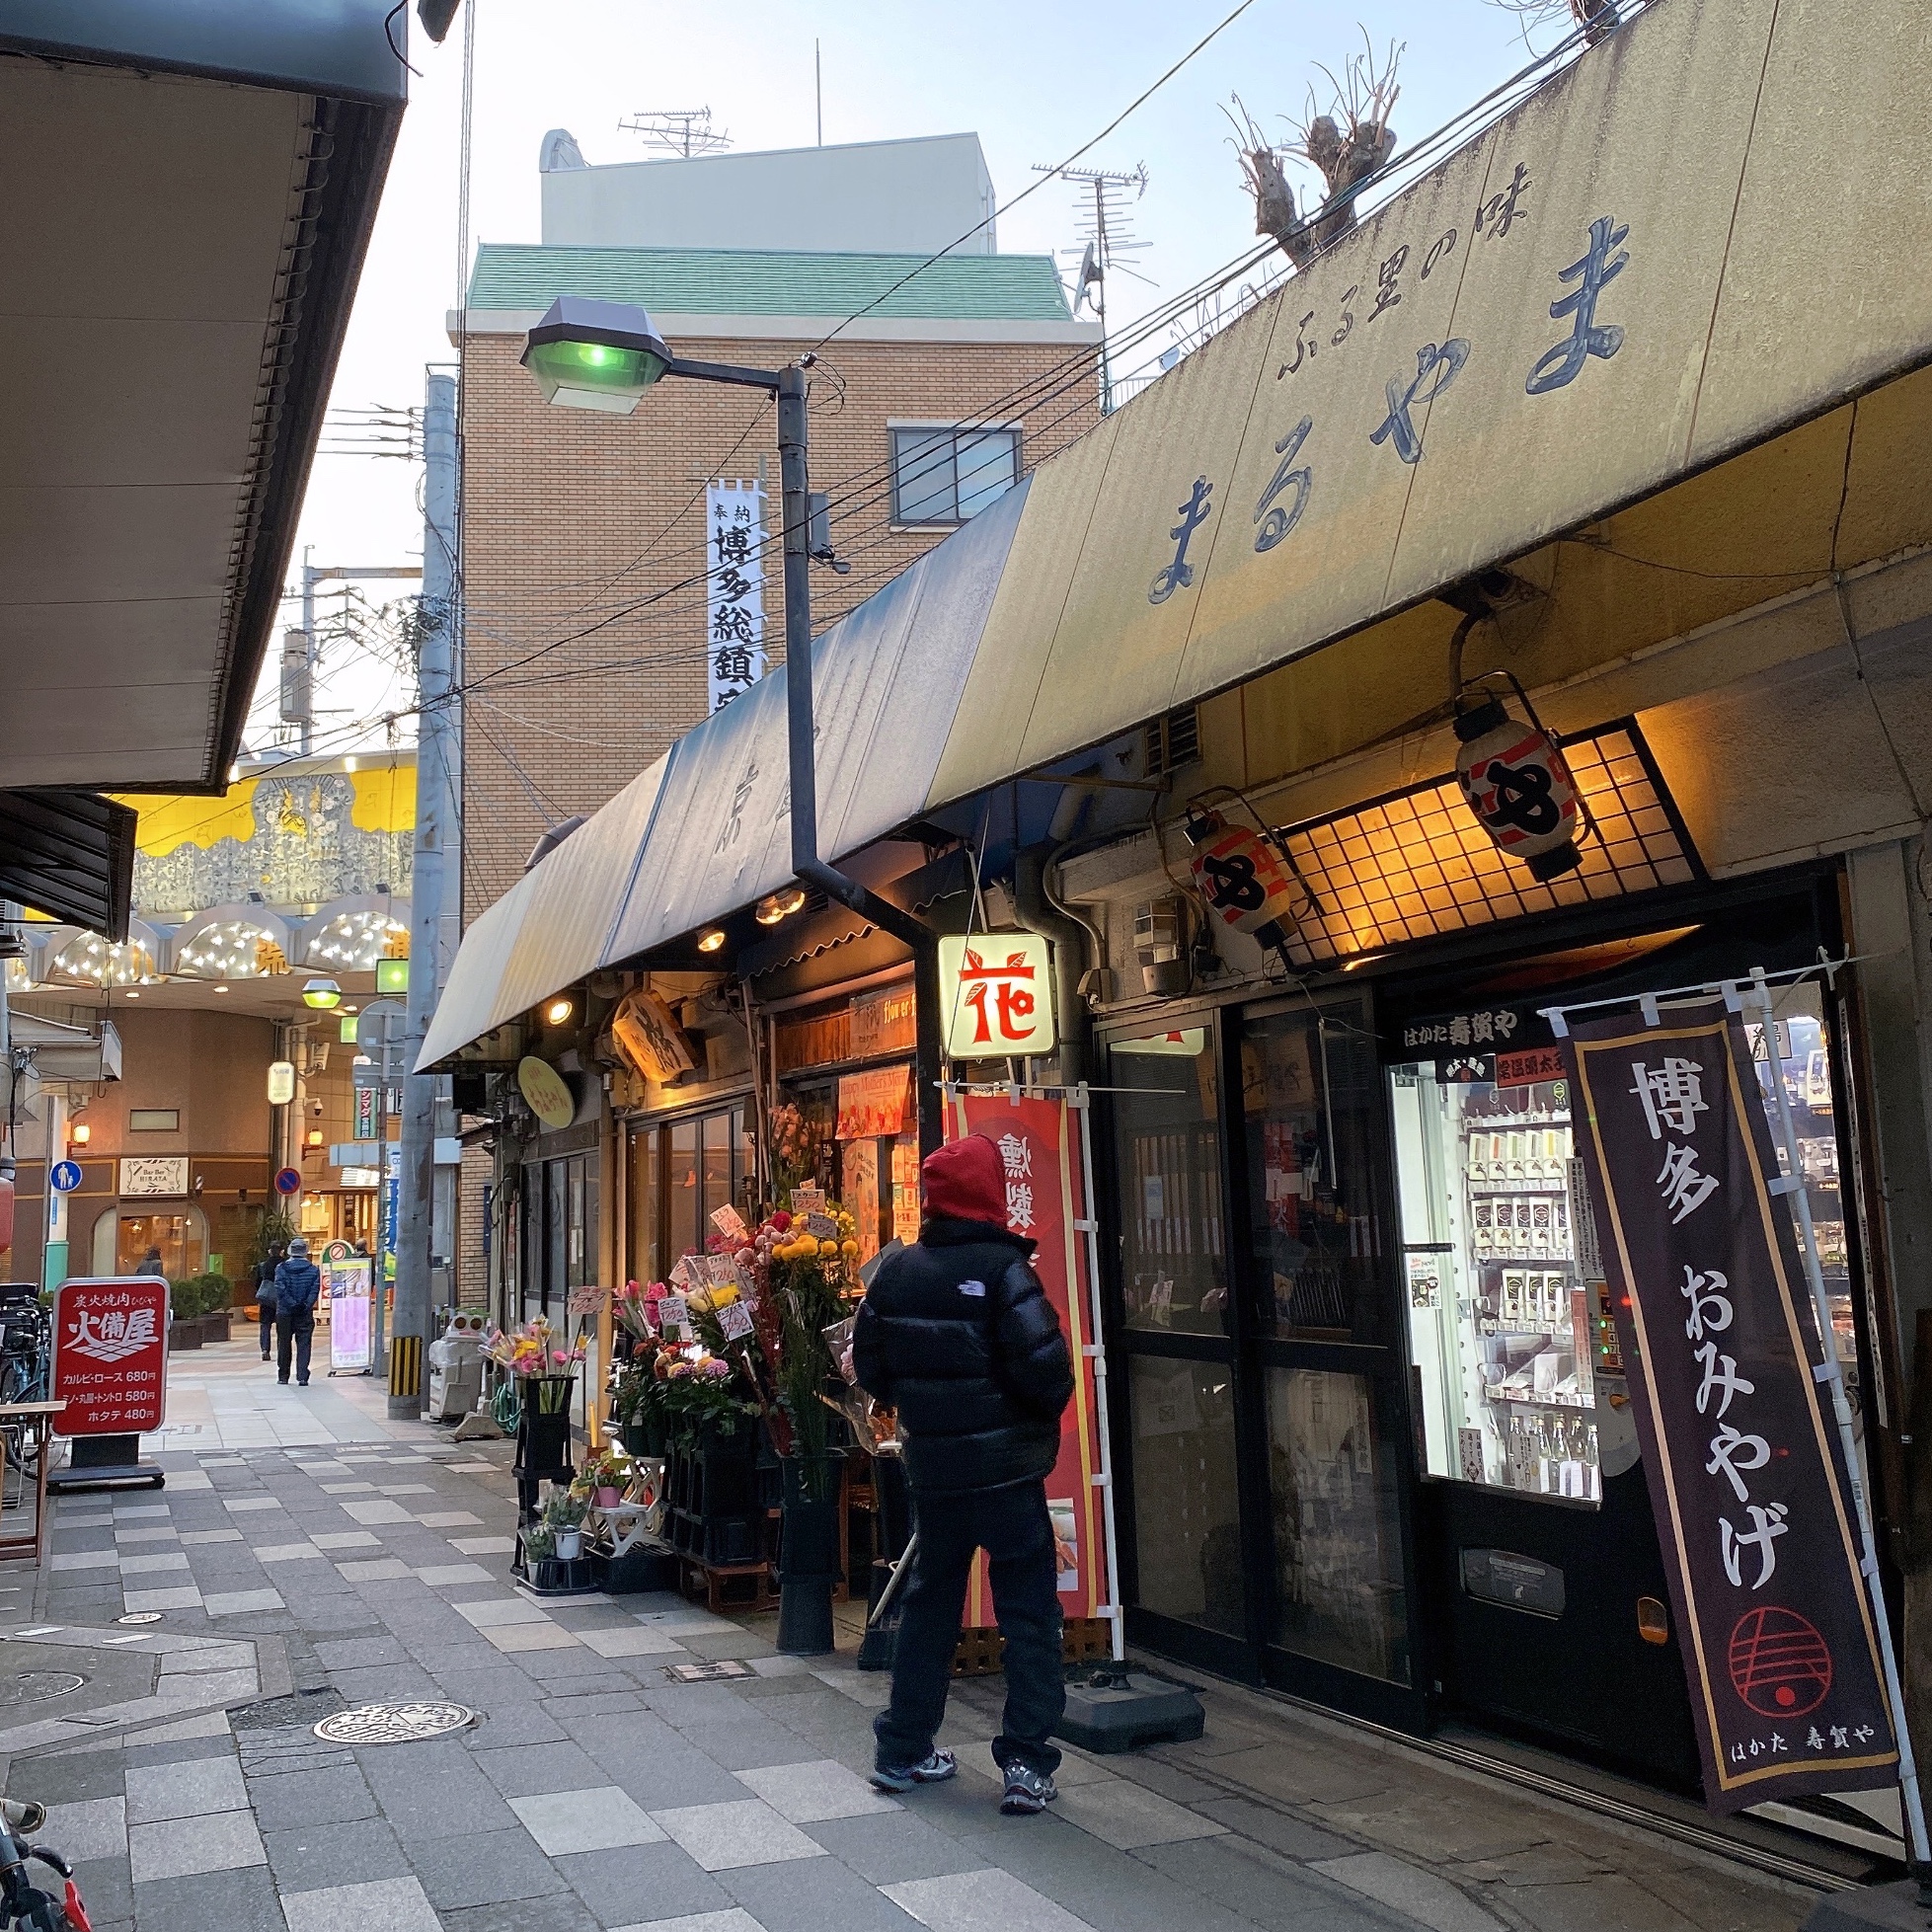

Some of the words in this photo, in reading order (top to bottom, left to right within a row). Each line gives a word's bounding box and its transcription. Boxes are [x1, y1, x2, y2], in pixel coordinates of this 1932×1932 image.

[1277, 162, 1532, 380] ふる里の味
[1147, 215, 1631, 605] まるやま
[958, 947, 1037, 1043] 花
[62, 1308, 160, 1350] 火備屋
[1629, 1056, 1720, 1225] 博多
[1680, 1265, 1789, 1590] おみやげ
[124, 1390, 156, 1402] 580円
[125, 1370, 156, 1382] 680円
[88, 1411, 121, 1423] ホタテ
[124, 1408, 155, 1420] 480円
[1731, 1732, 1788, 1763] はかた
[1806, 1725, 1875, 1750] 寿賀や
